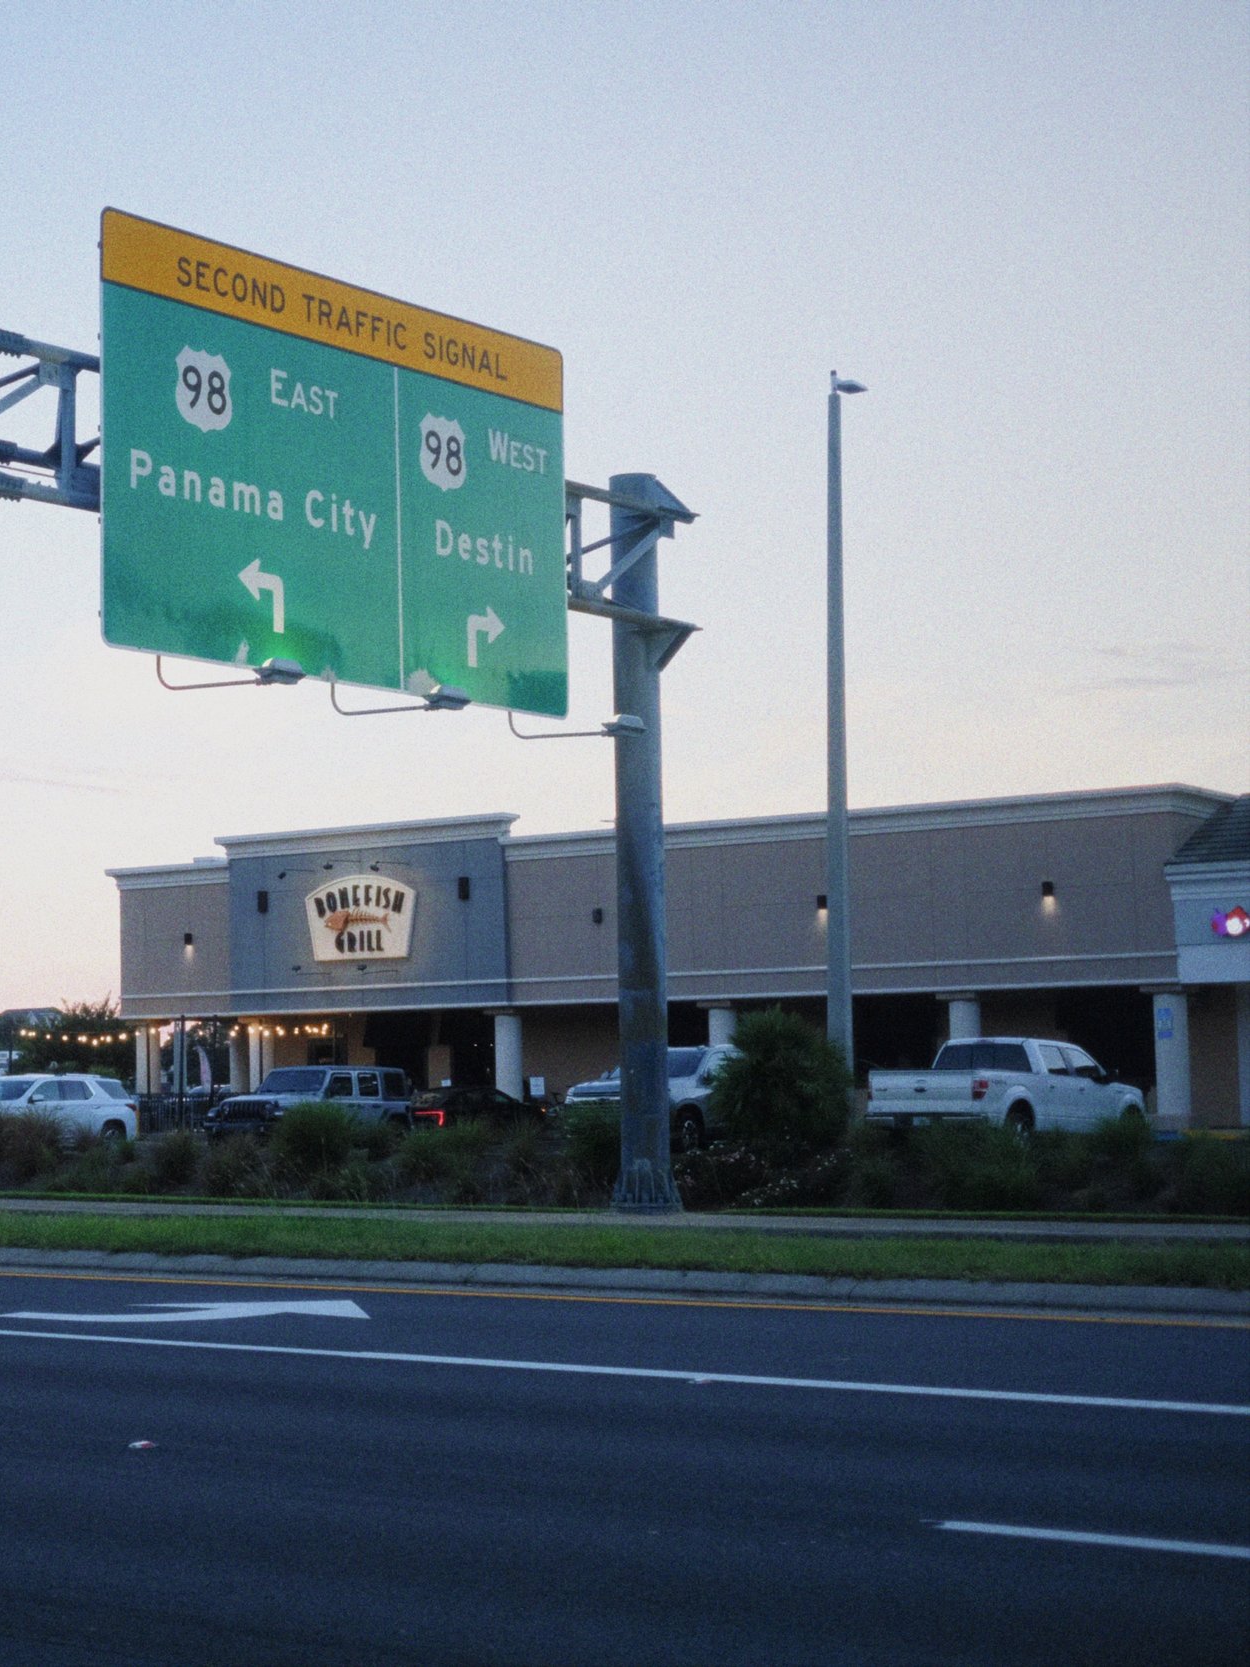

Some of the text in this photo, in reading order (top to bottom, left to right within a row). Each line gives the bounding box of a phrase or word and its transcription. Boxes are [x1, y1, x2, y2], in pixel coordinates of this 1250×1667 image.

[176, 256, 508, 381] SECOND TRAFFIC SIGNAL
[182, 365, 227, 416] 98
[270, 367, 339, 420] EAST
[425, 430, 463, 476] 98
[488, 428, 548, 475] WEST
[130, 448, 377, 550] Panama City
[435, 519, 533, 575] Destin
[313, 884, 406, 918] BONEFISH
[335, 930, 385, 954] GRILL
